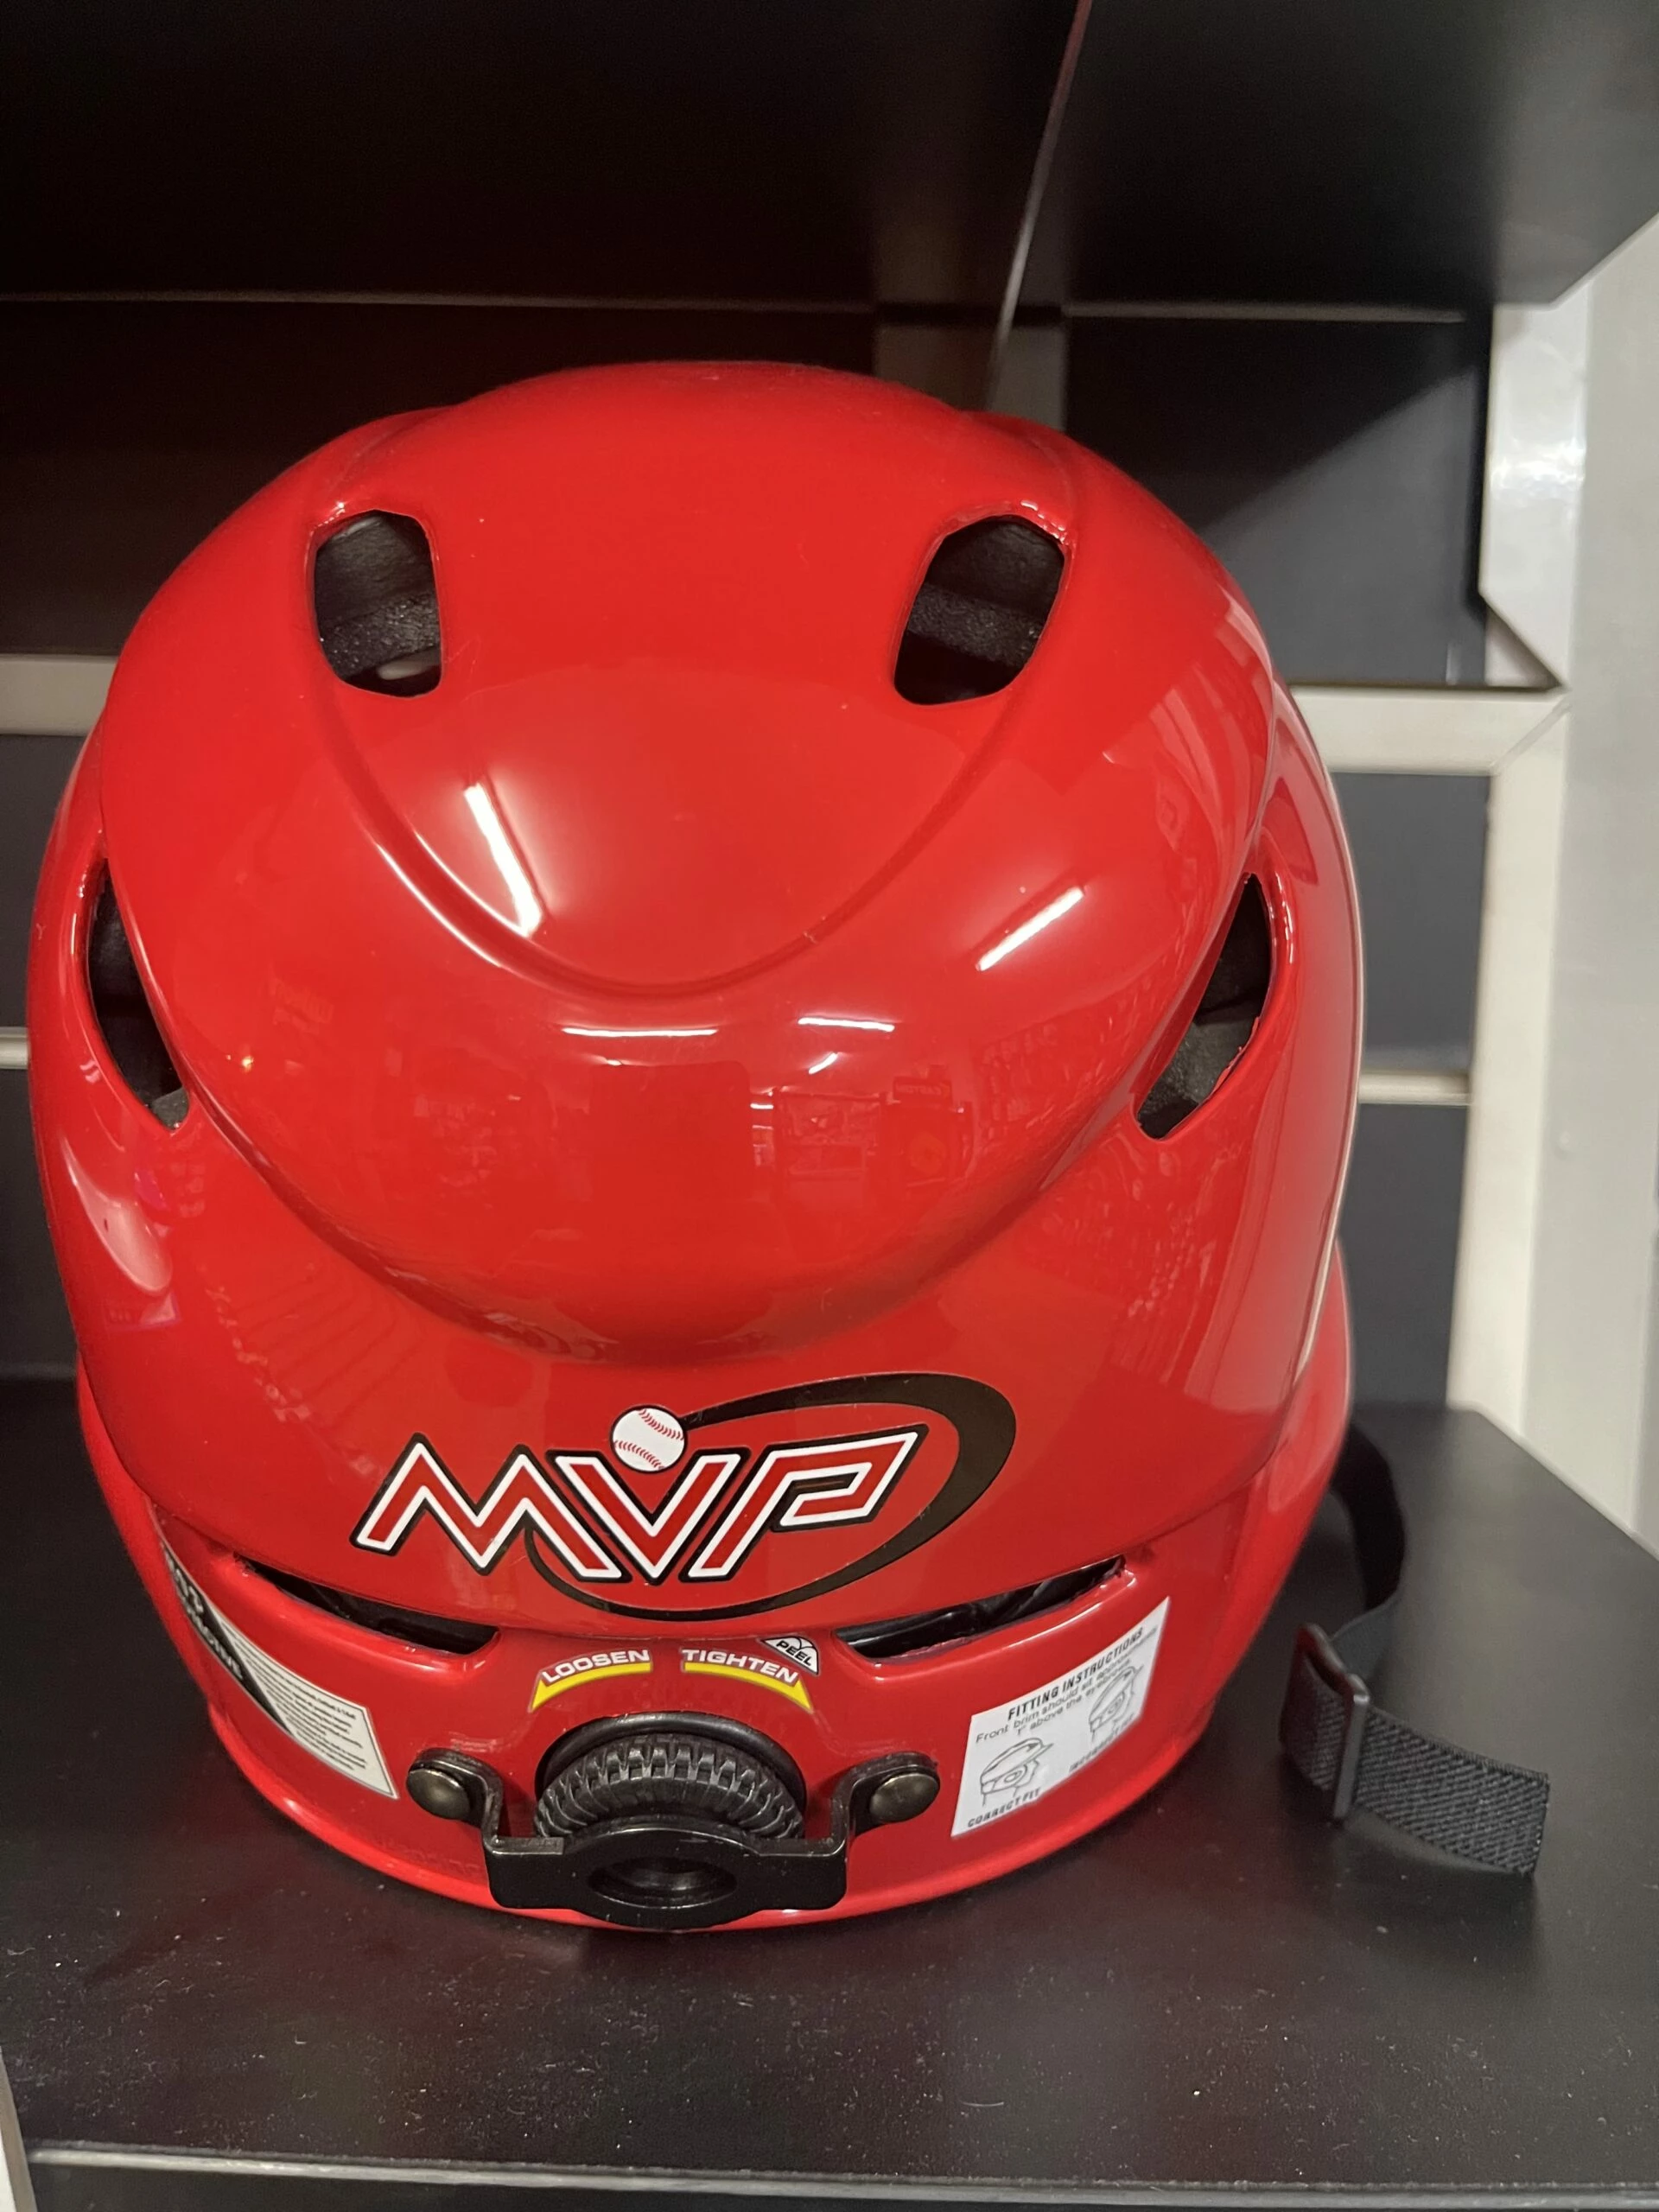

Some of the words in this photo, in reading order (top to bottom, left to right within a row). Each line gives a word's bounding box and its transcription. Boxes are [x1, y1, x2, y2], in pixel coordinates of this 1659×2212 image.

[349, 1422, 929, 1586] MVP
[541, 1649, 651, 1683] LOOSEN
[681, 1649, 799, 1683] TIGHTEN
[778, 1639, 813, 1667] PEEL
[1007, 1686, 1059, 1721] FITTING
[1062, 1627, 1143, 1693] INSTRUCTIONS
[976, 1724, 1009, 1744] Front
[1013, 1709, 1040, 1729] brim
[1042, 1686, 1079, 1715] should
[1030, 1707, 1064, 1731] above
[1065, 1694, 1083, 1709] the
[967, 1797, 1021, 1827] CORRECT
[1021, 1786, 1041, 1802] FIT
